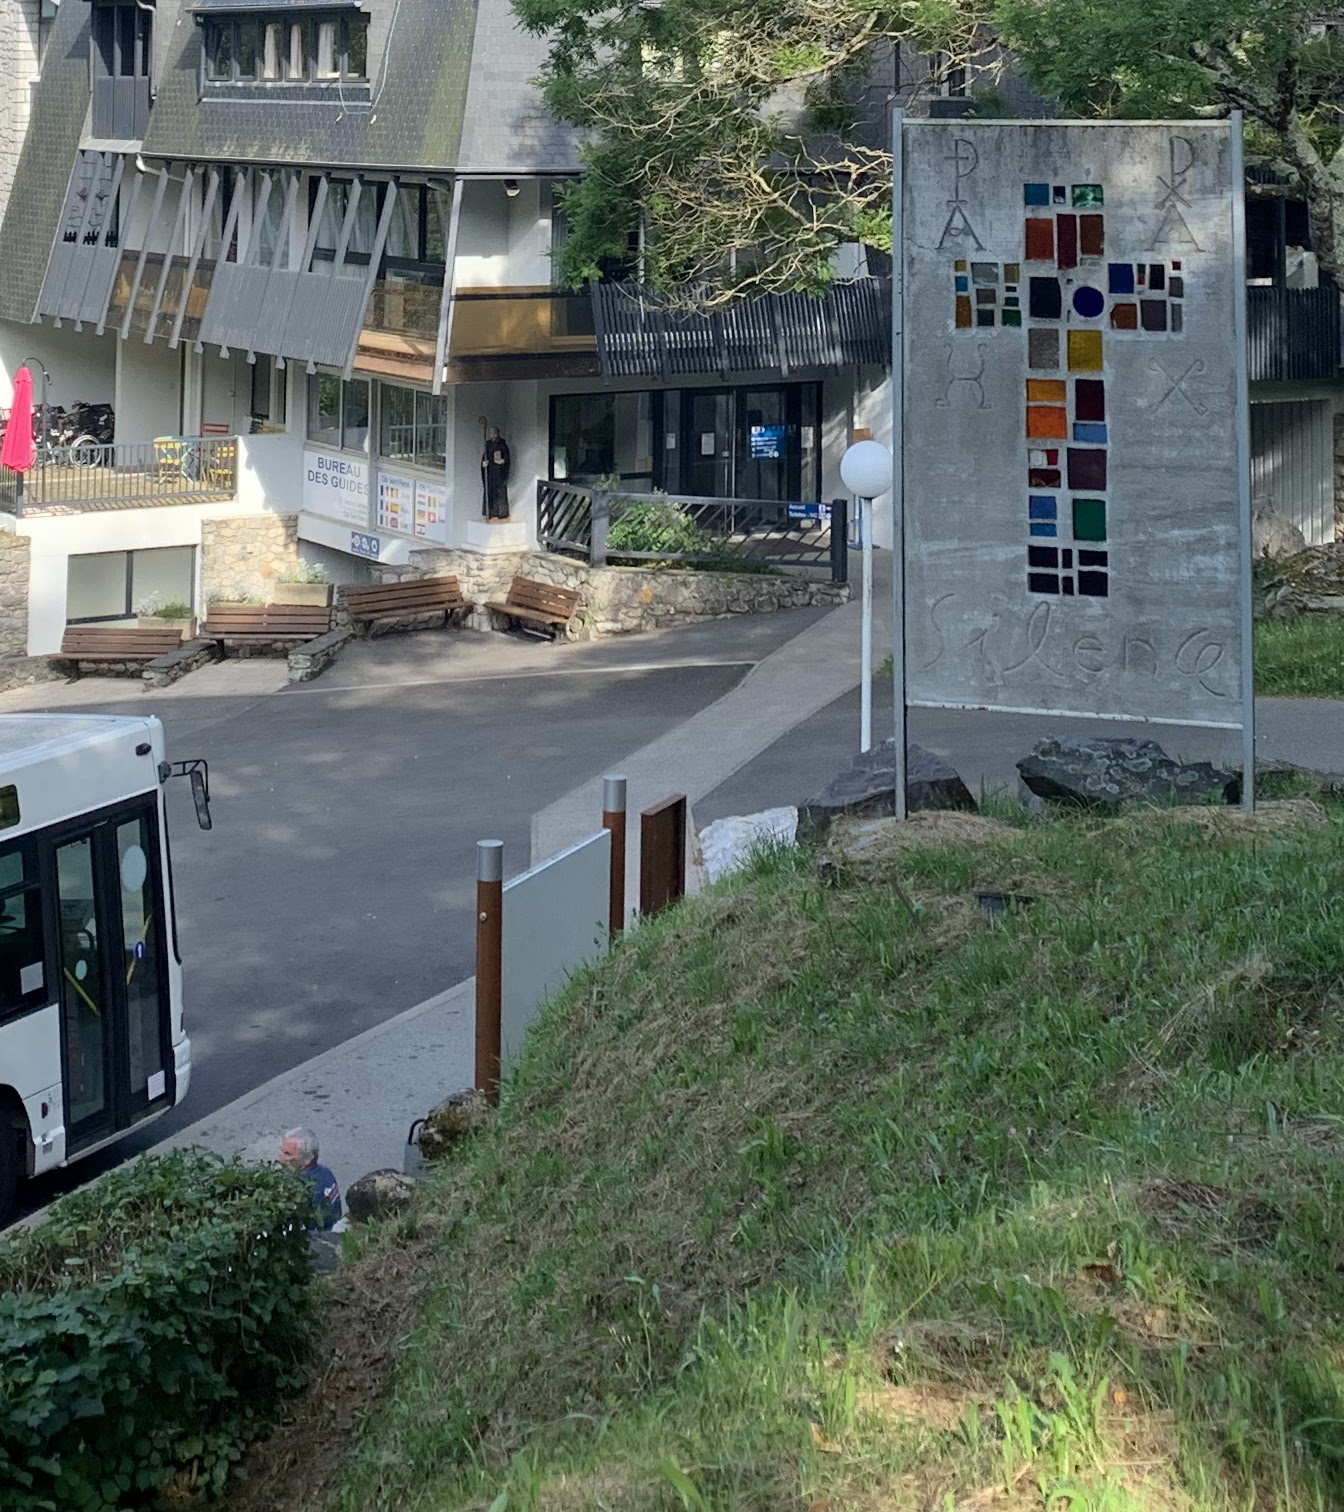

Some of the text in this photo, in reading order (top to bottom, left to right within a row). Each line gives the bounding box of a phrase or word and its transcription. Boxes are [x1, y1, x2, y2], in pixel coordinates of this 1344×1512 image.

[317, 456, 361, 478] BUREAU
[307, 469, 369, 496] DES GUIDES
